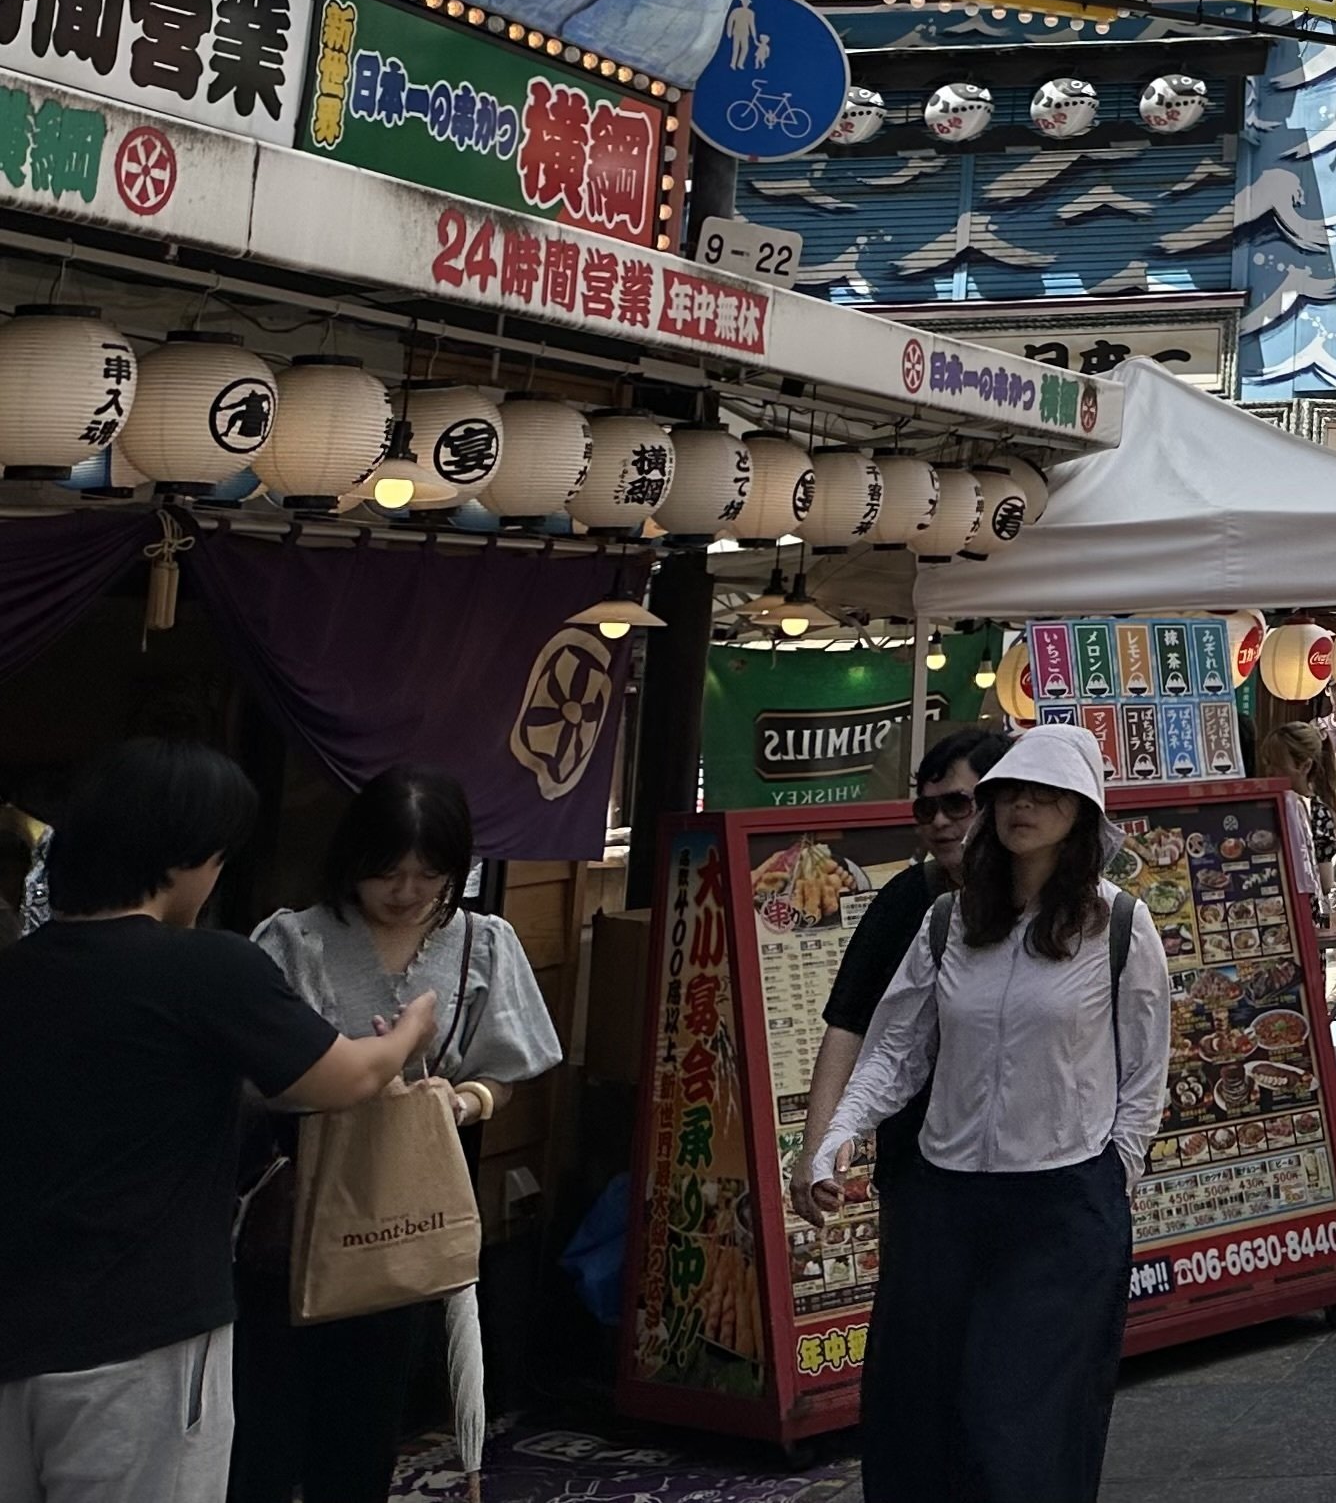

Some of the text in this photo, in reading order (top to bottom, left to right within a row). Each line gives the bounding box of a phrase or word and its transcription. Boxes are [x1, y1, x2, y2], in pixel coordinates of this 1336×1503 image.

[314, 0, 355, 143] 新世界
[521, 79, 659, 232] 横綱
[431, 209, 657, 331] 24時間営業
[665, 273, 765, 348] 年中無休
[77, 342, 132, 447] 一串入魂
[624, 443, 667, 506] 横綱
[1043, 630, 1061, 673] いちご
[1085, 629, 1099, 672] メロン
[1126, 630, 1141, 672] レモン
[1164, 629, 1182, 671] 抹茶
[1202, 629, 1219, 670] みぞれ
[1127, 711, 1140, 752] コーラ
[1166, 709, 1179, 750] ラムネ
